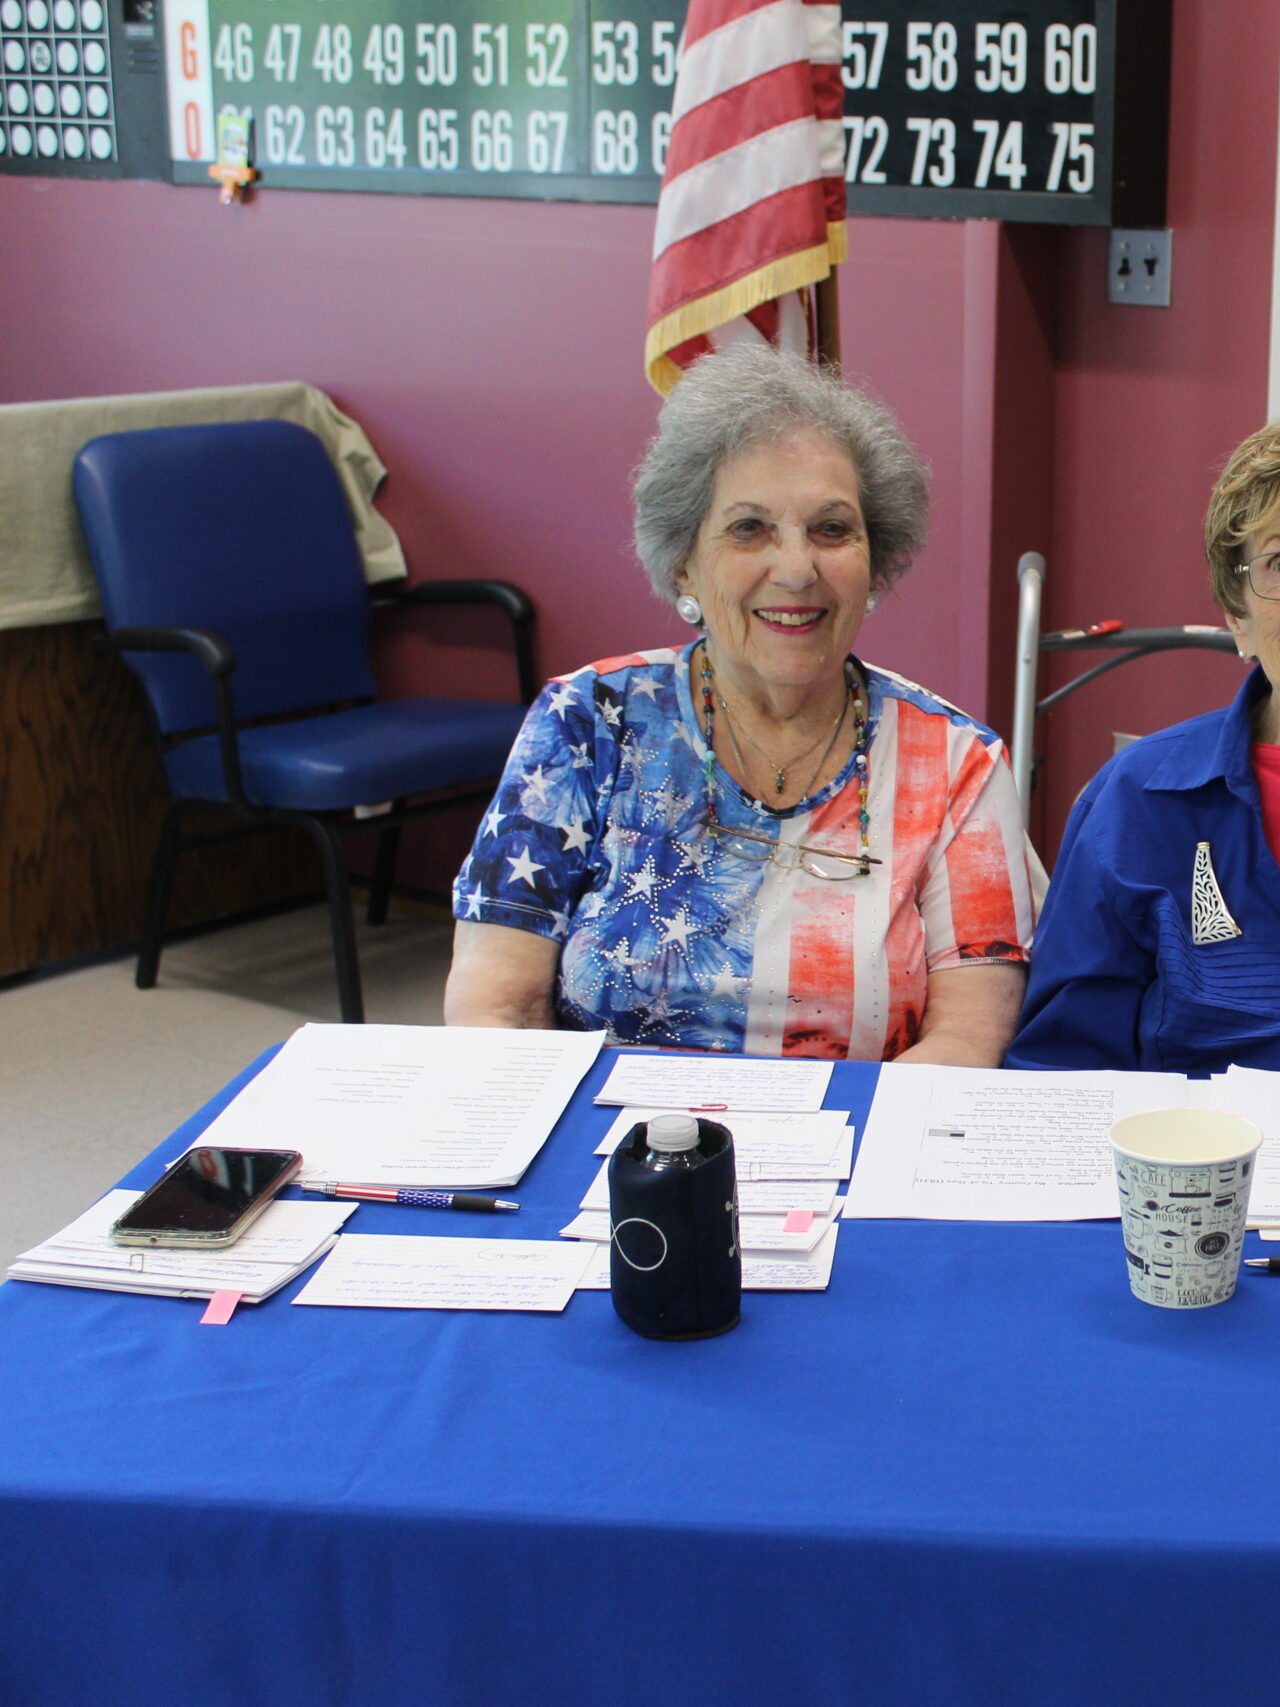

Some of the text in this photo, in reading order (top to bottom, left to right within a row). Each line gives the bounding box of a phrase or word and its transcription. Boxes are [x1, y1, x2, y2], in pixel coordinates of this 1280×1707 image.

[180, 21, 199, 81] G
[214, 23, 255, 84] 46
[263, 25, 301, 84] 47
[312, 23, 353, 84] 48
[363, 23, 404, 86] 49
[416, 23, 457, 87] 50
[471, 24, 509, 88] 51
[525, 24, 569, 89] 52
[592, 21, 638, 87] 53
[841, 21, 889, 90] 57
[905, 21, 957, 92] 58
[974, 23, 1026, 94] 59
[1044, 23, 1097, 95] 60
[265, 107, 305, 165] 62
[316, 106, 355, 167] 63
[364, 107, 407, 169] 64
[417, 108, 459, 171] 65
[470, 109, 512, 173] 66
[527, 111, 568, 174] 67
[596, 110, 638, 175] 68
[842, 115, 889, 184] 72
[906, 117, 956, 187] 73
[972, 120, 1026, 190] 74
[1046, 123, 1094, 194] 75
[1155, 1213, 1189, 1224] HOUSE
[1160, 1203, 1202, 1214] Coffee
